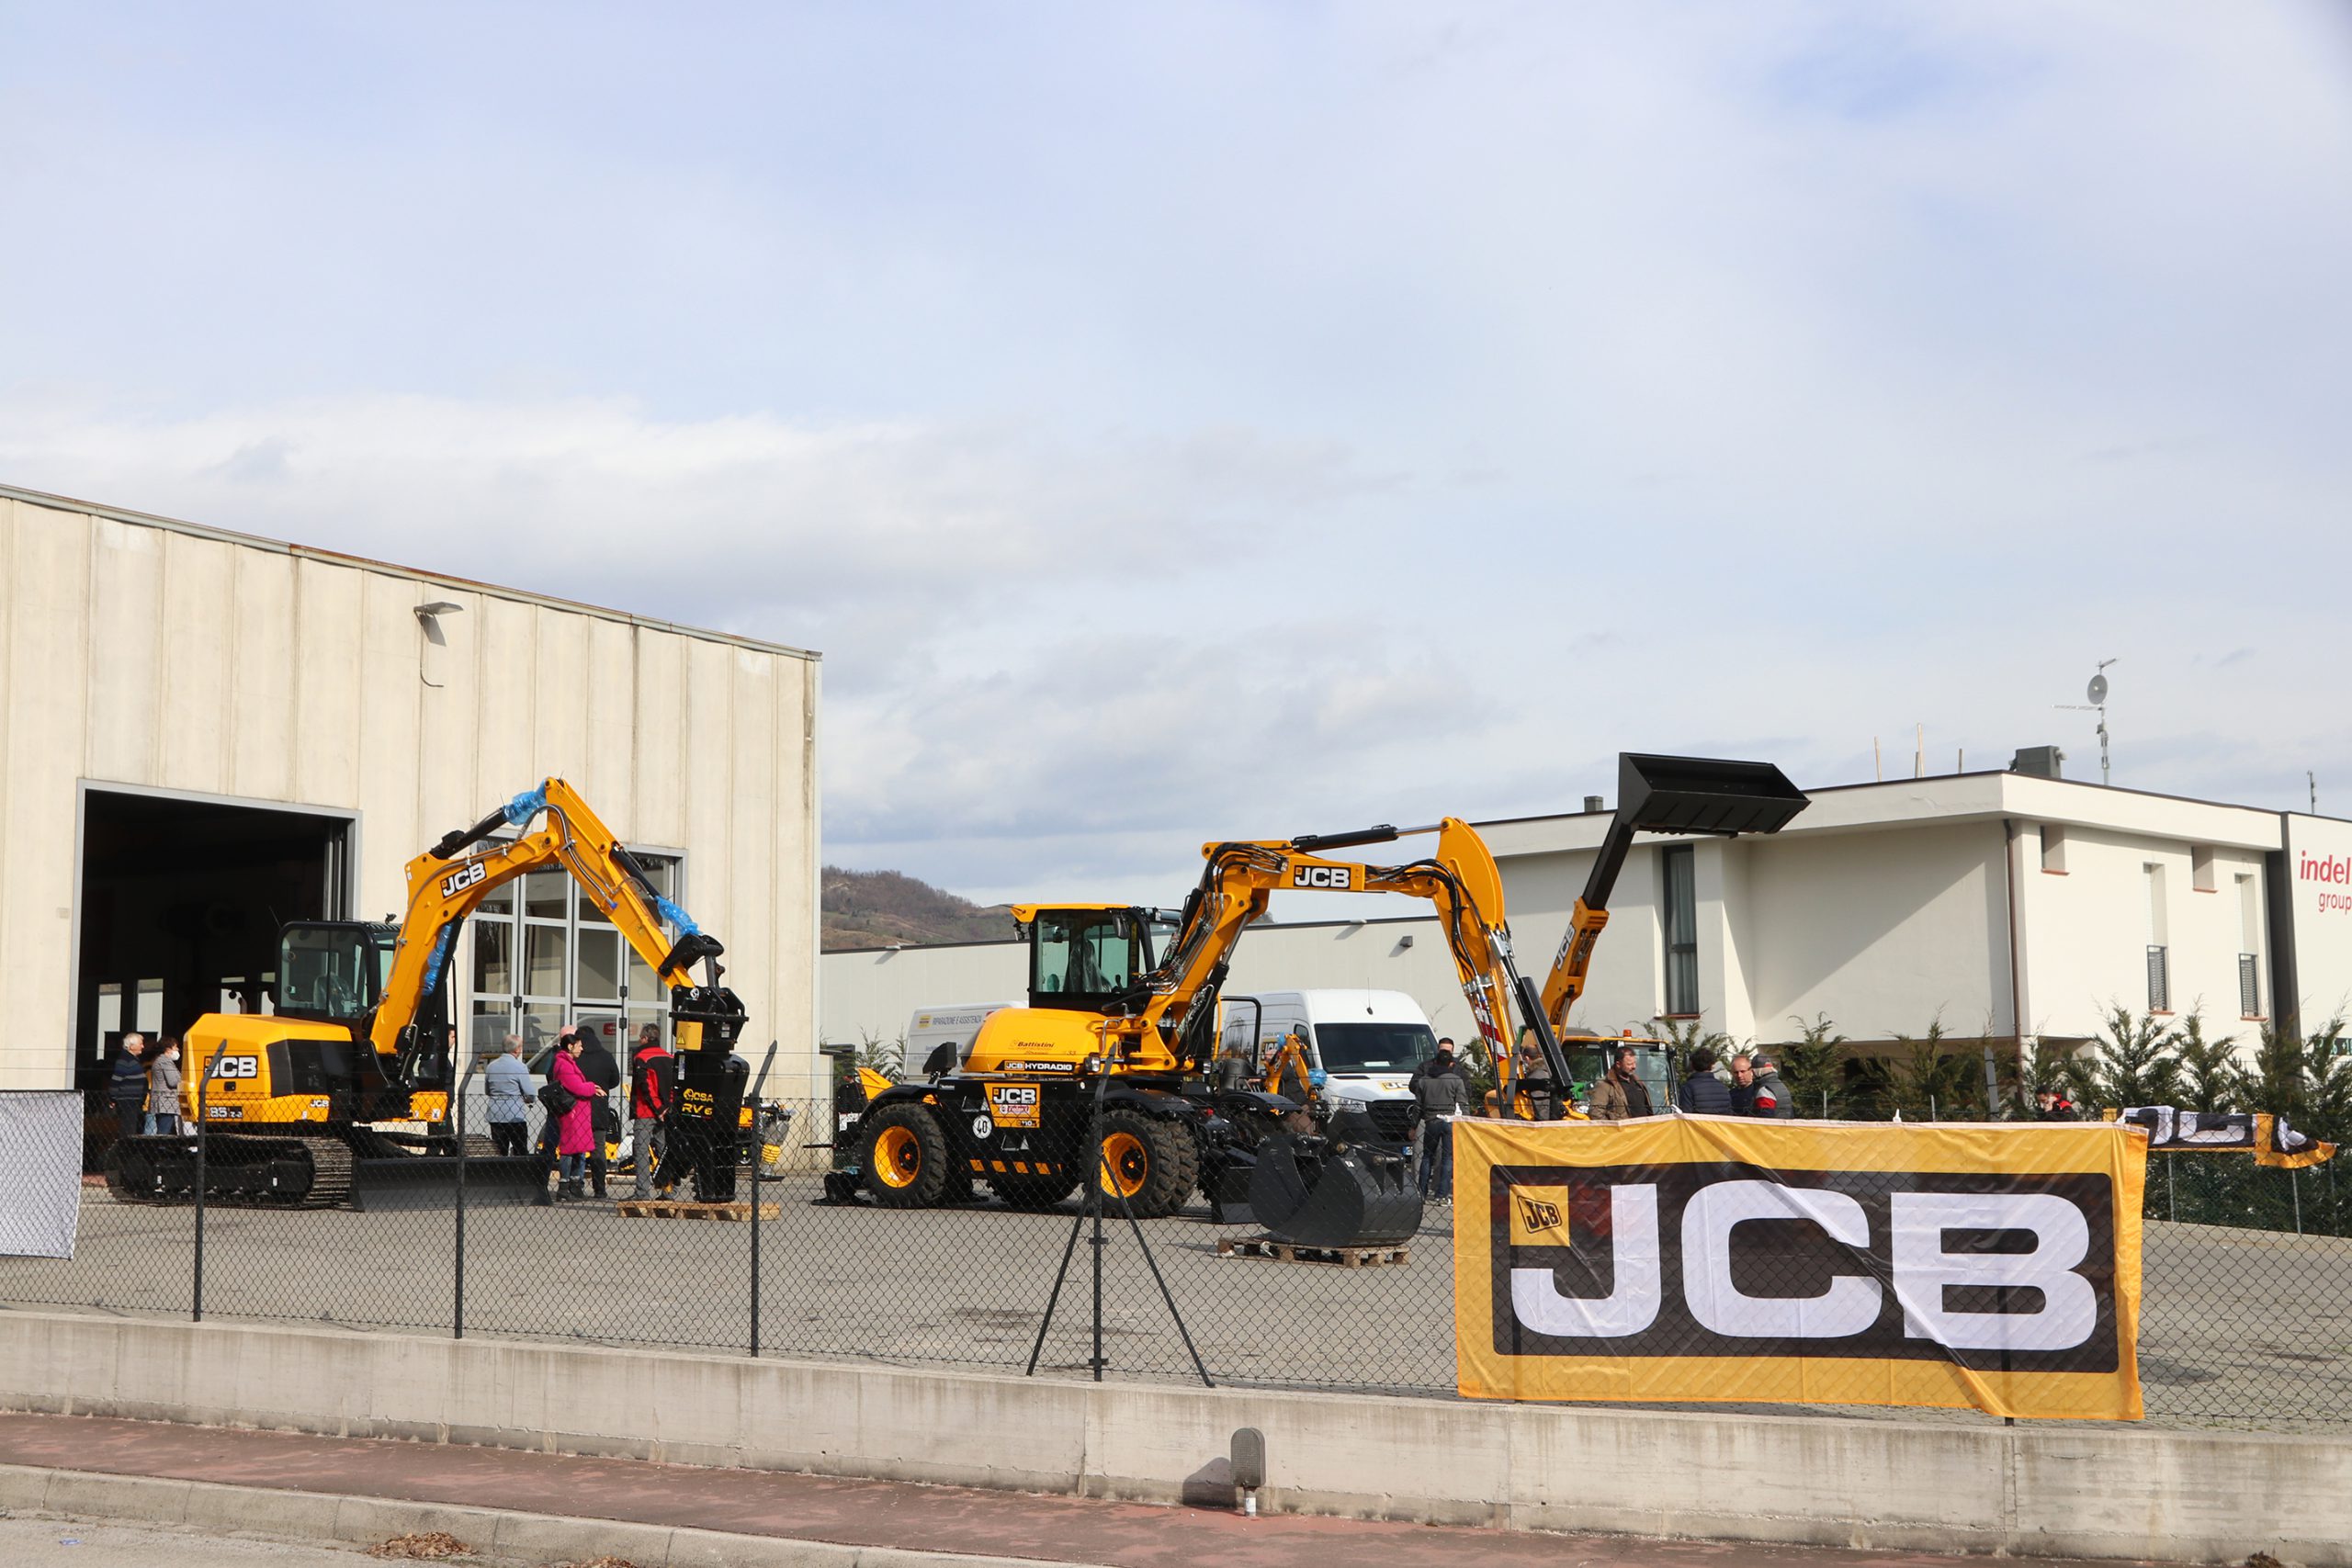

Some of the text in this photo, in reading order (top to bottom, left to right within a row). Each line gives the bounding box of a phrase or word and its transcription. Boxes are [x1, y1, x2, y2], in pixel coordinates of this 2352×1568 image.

[1295, 866, 1350, 888] JCB
[2300, 850, 2351, 885] indel
[442, 863, 486, 897] JCB
[2318, 893, 2352, 915] group
[1556, 924, 1576, 970] JCB
[1024, 1063, 1072, 1071] HYDRADIG
[310, 1100, 330, 1108] JCB
[993, 1089, 1036, 1104] JCB
[209, 1107, 228, 1118] 85
[978, 1121, 988, 1134] 40
[1525, 1201, 1559, 1229] JCB
[1510, 1179, 2098, 1351] JCB
